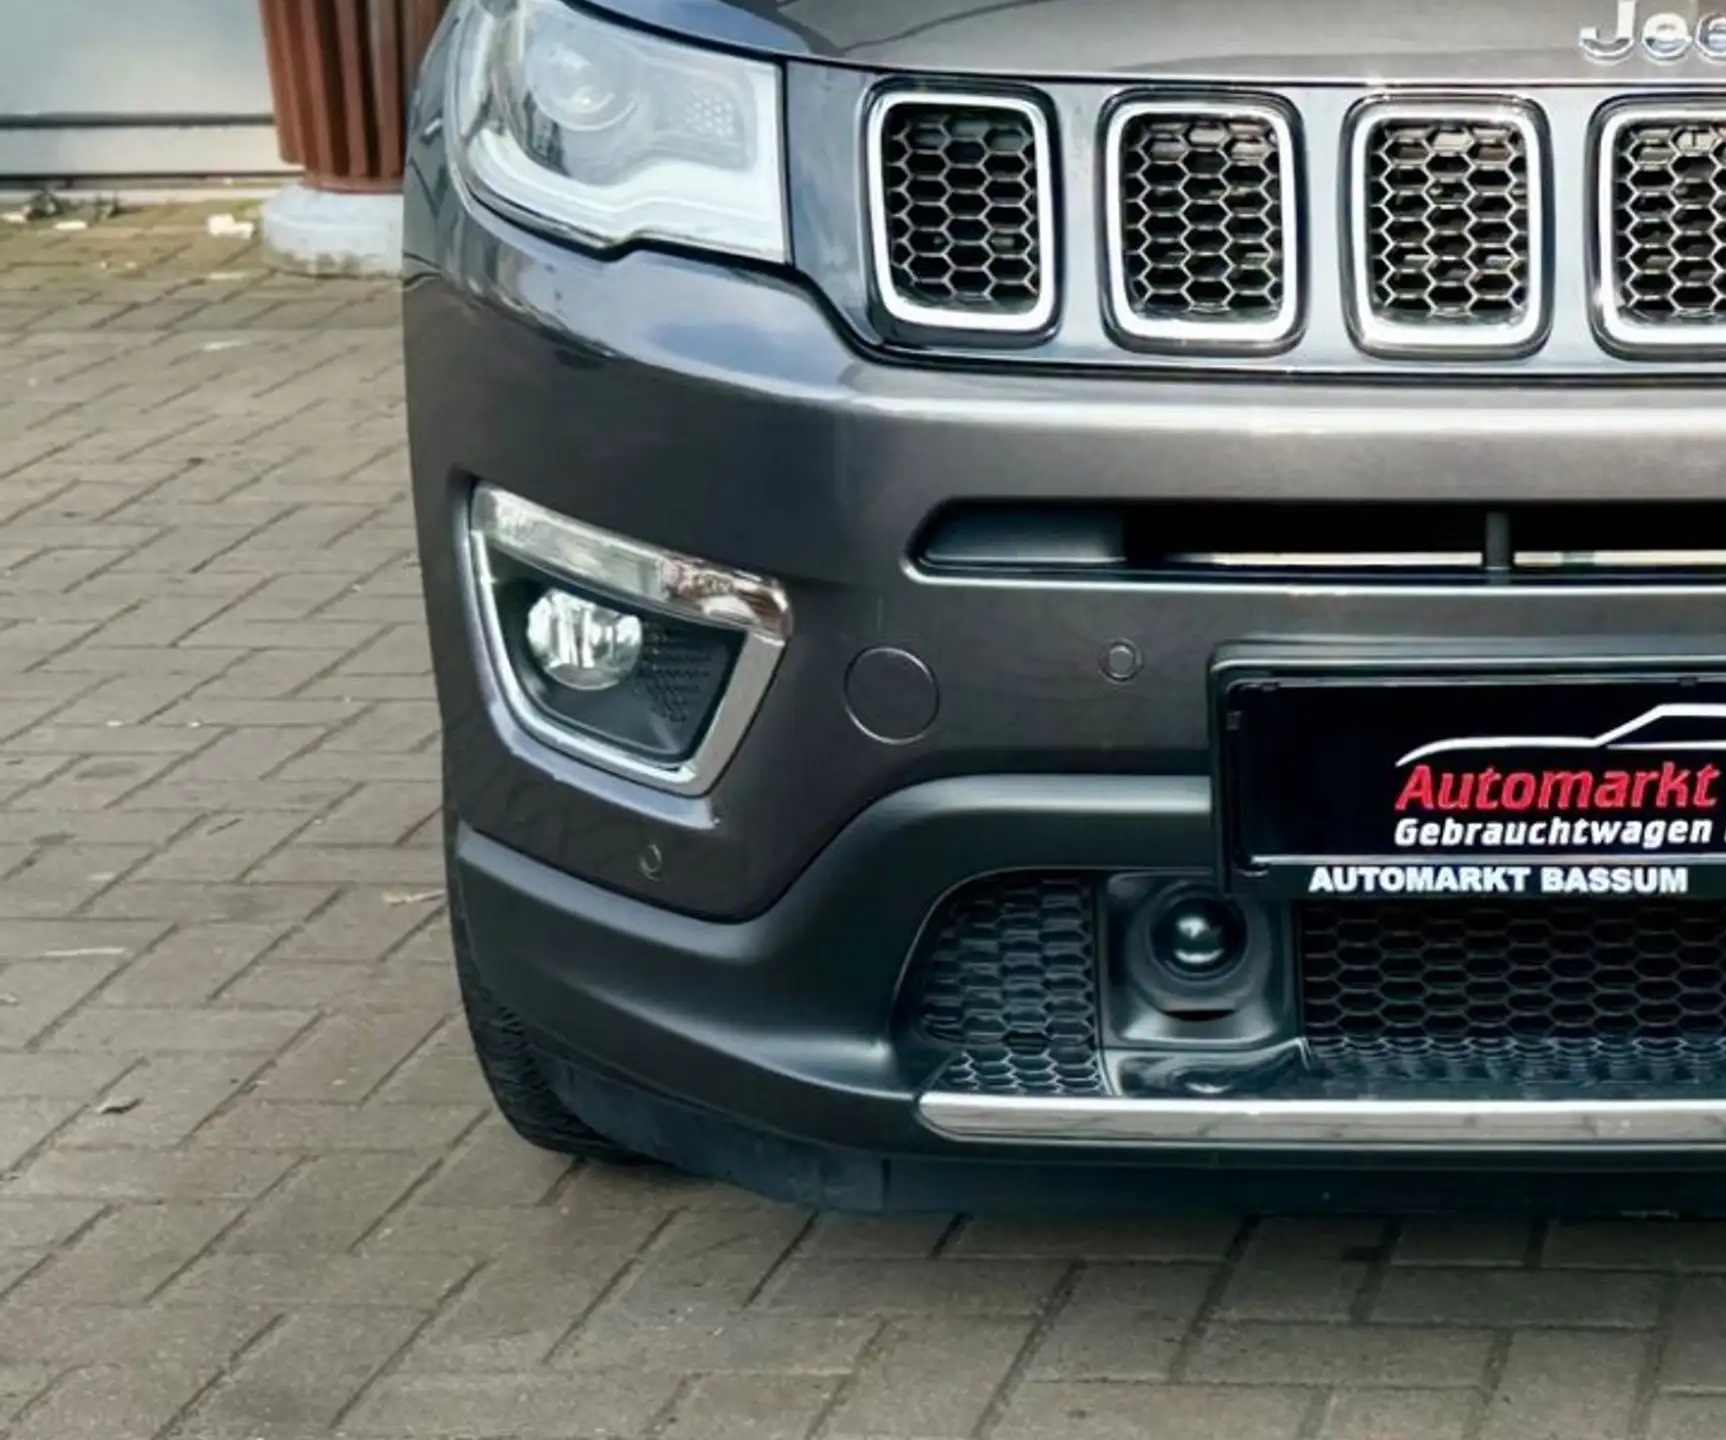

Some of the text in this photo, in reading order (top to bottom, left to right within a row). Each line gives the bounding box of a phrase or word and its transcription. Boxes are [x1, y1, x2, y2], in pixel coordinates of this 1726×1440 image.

[1394, 761, 1720, 810] Automarkt
[1394, 817, 1713, 849] Gebrauchtwagen
[1308, 866, 1689, 893] AUTOMARKT BASSUM
